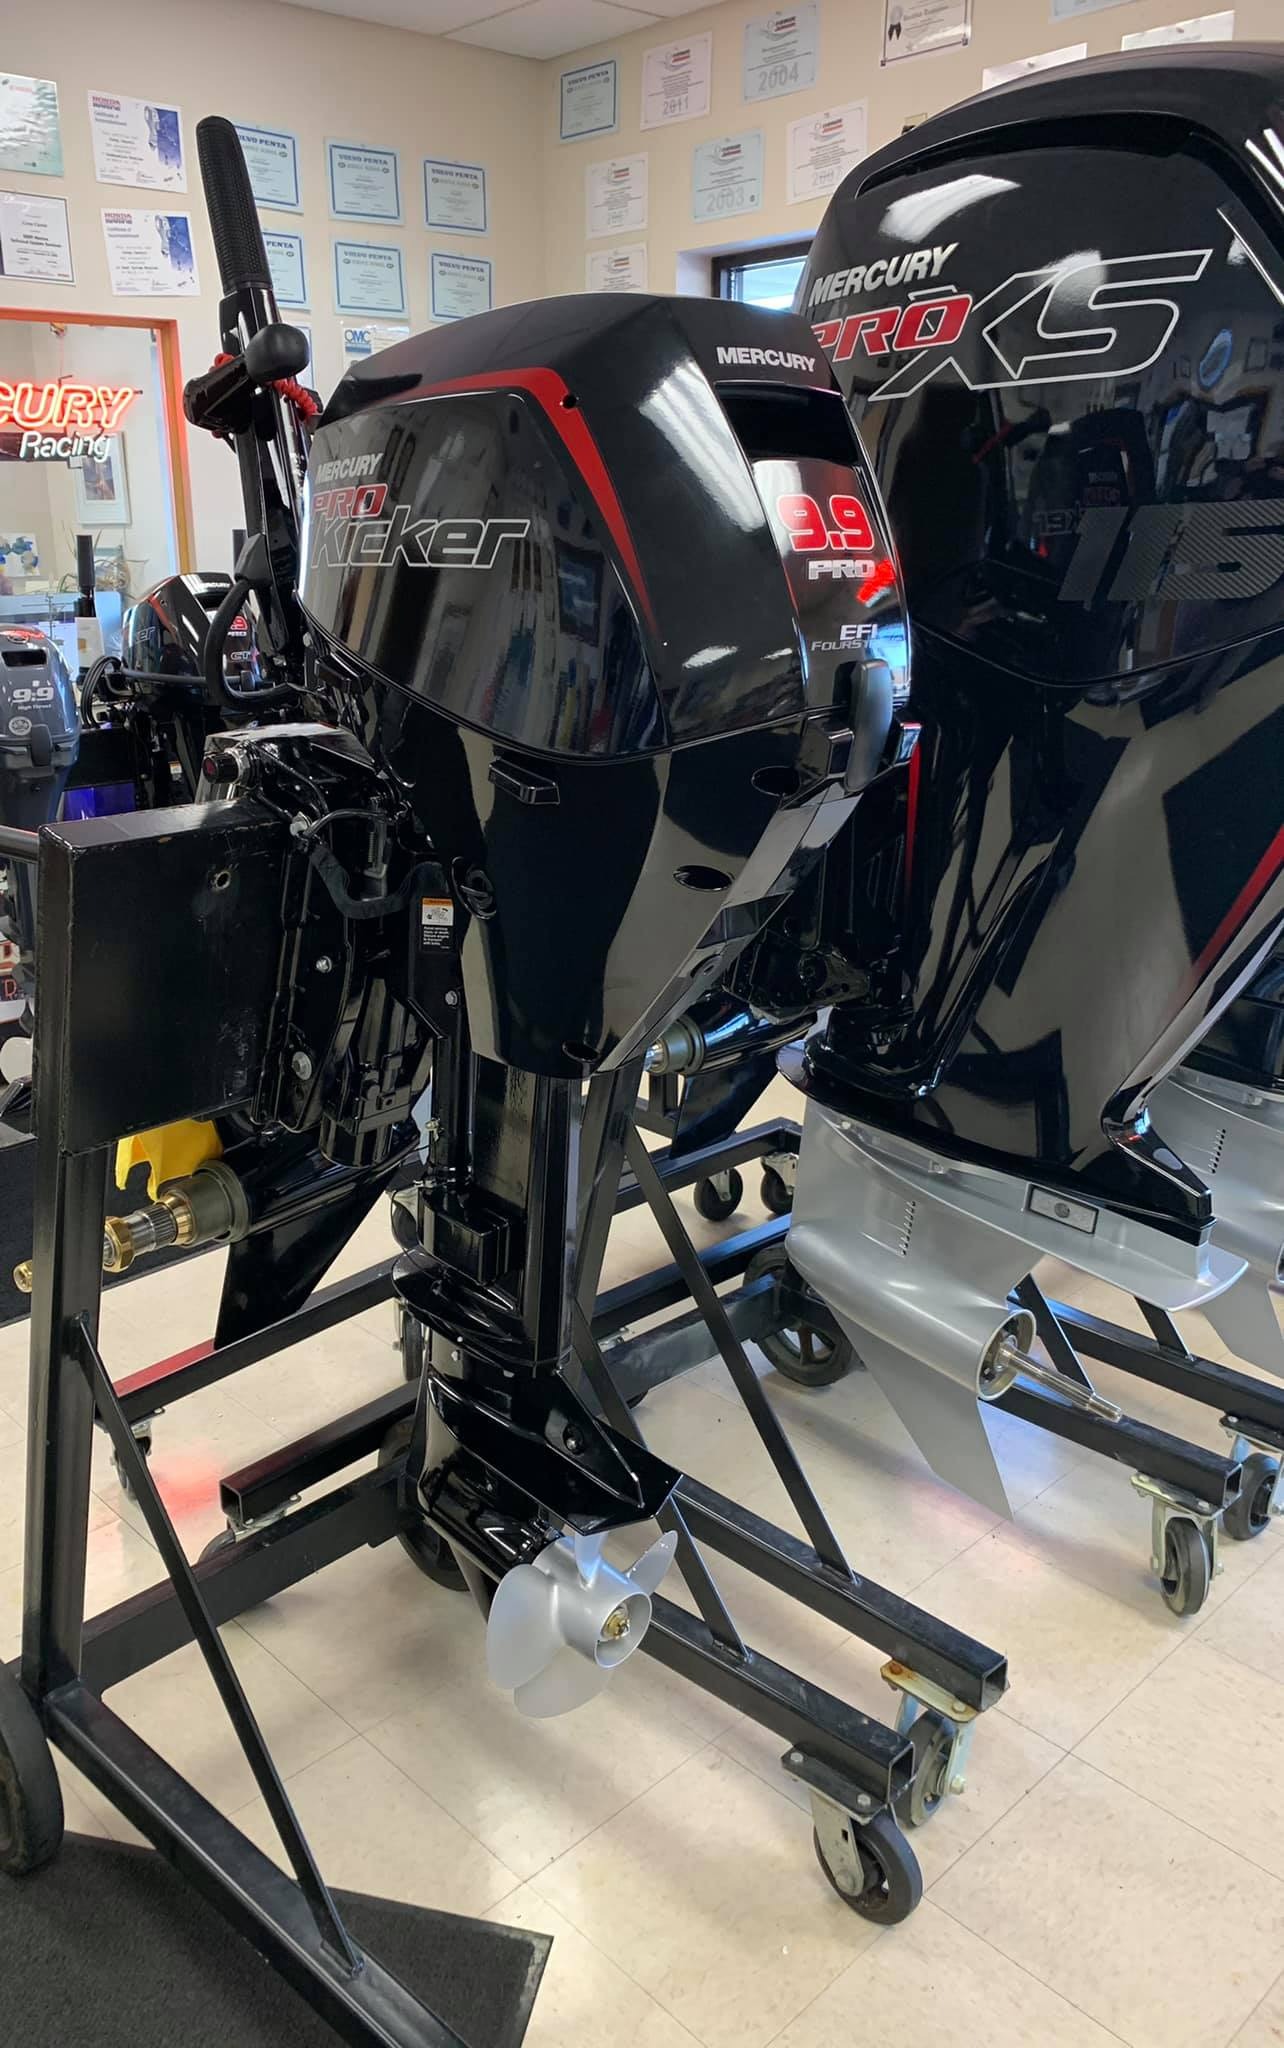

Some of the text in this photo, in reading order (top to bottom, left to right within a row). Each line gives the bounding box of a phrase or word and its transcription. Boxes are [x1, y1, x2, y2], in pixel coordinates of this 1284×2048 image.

[92, 95, 121, 106] HONDA
[104, 212, 132, 221] HONDA
[808, 242, 960, 308] MERCURY
[716, 346, 816, 373] MERCURY
[19, 430, 112, 463] Racing
[314, 452, 384, 484] MERCURY
[312, 483, 390, 520] PRO
[311, 505, 531, 569] Kicker
[776, 494, 876, 552] 9.9
[808, 559, 877, 581] PRO
[839, 623, 879, 641] EFI
